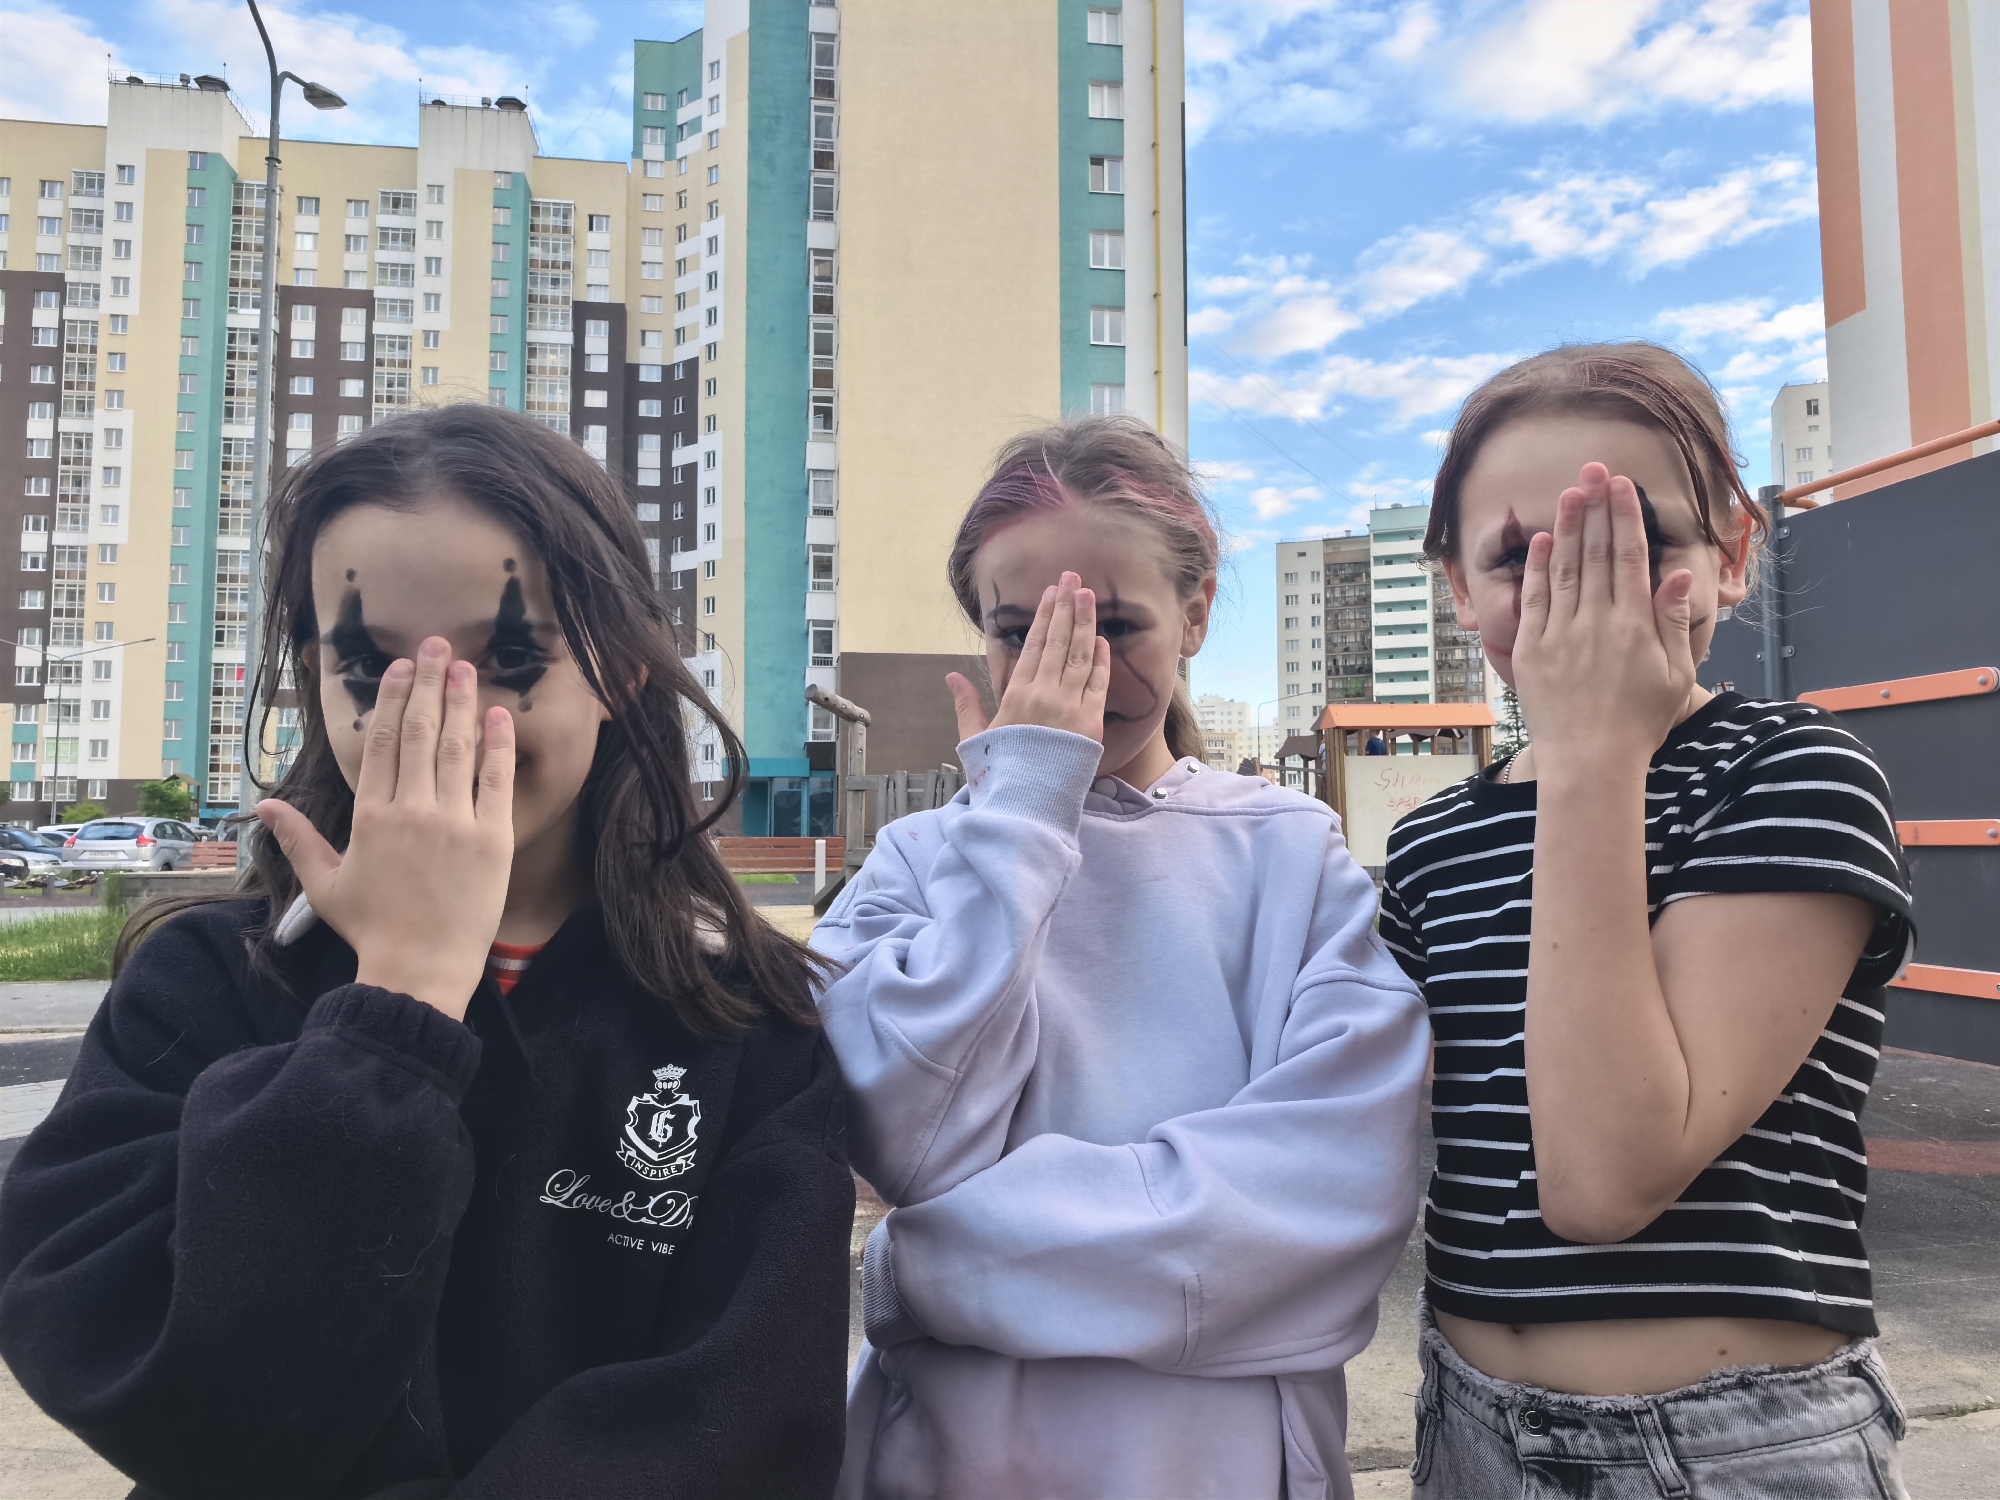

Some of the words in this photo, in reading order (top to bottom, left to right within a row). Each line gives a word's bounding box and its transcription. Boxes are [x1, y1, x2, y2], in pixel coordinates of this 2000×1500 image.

[630, 1158, 678, 1178] INSPIRE
[607, 1232, 645, 1250] ACTIVE
[651, 1241, 676, 1255] VIBE
